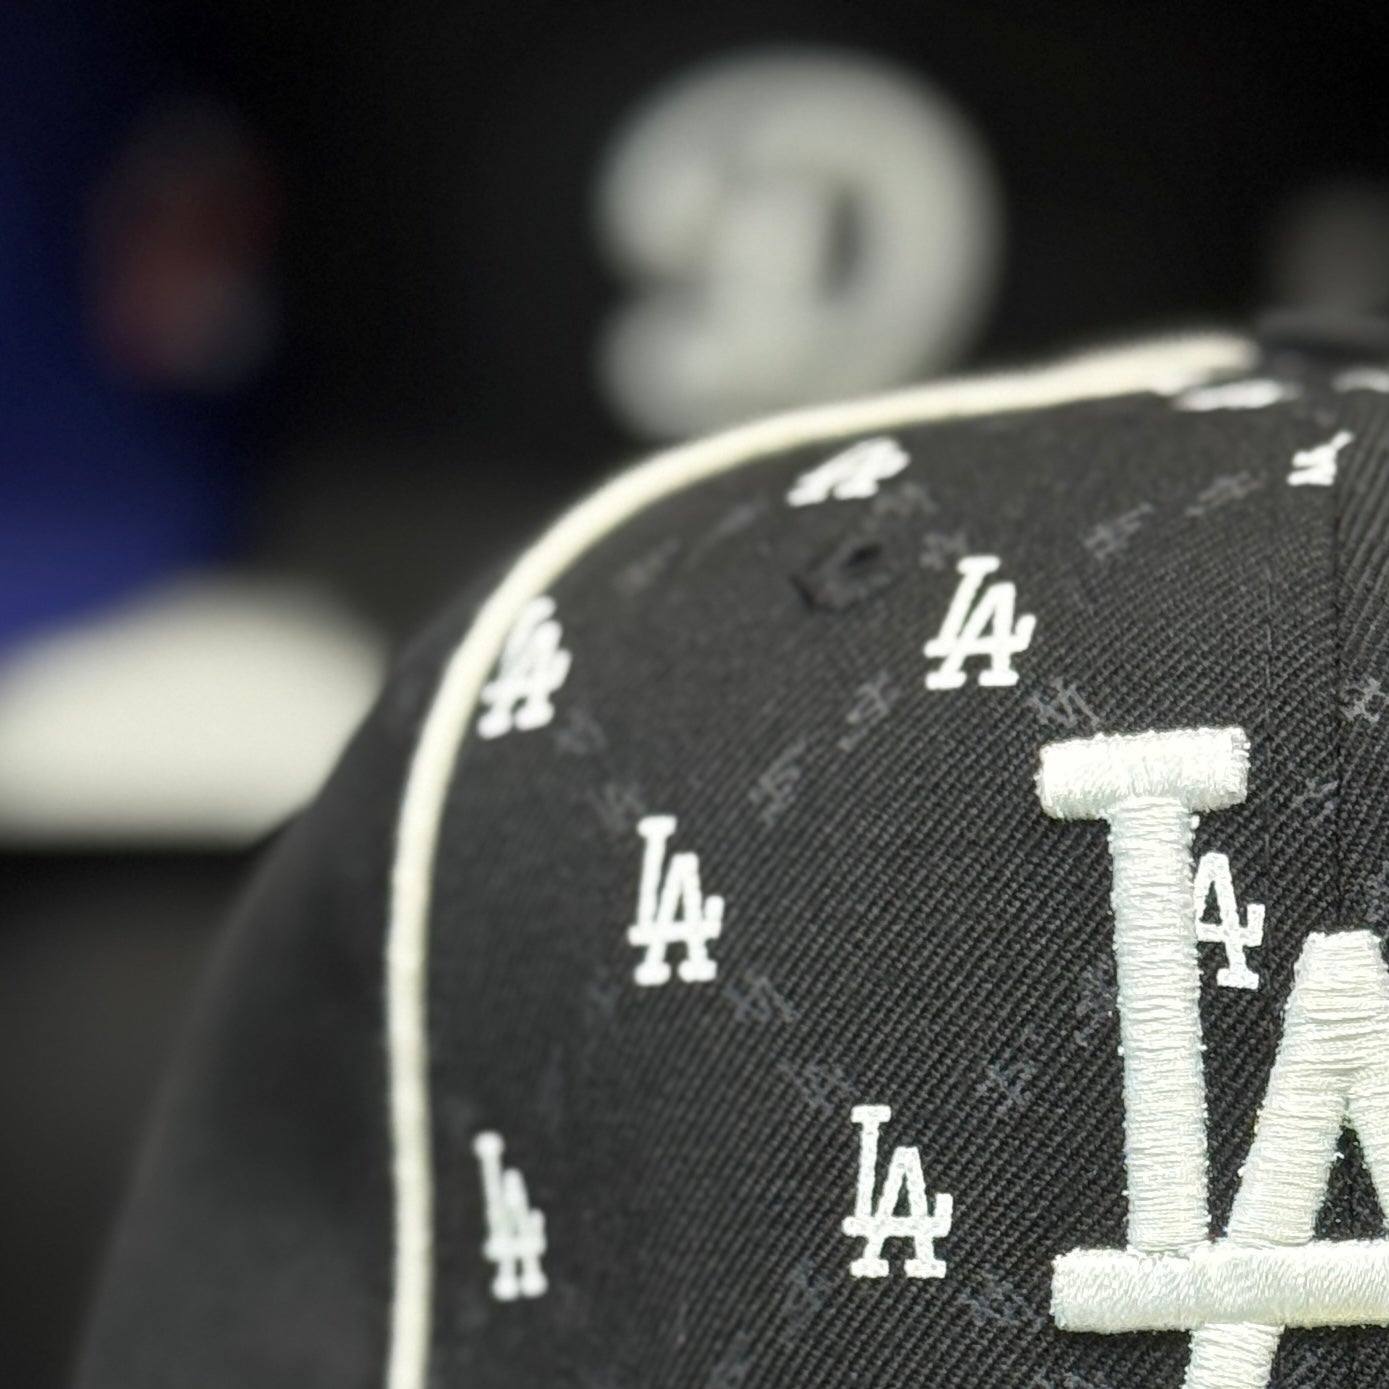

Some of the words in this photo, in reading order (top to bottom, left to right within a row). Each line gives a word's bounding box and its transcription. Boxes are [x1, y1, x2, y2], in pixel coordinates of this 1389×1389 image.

[923, 555, 1037, 690] LA
[627, 815, 725, 986] LA
[473, 1130, 548, 1301] LA
[841, 1104, 959, 1280] LA
